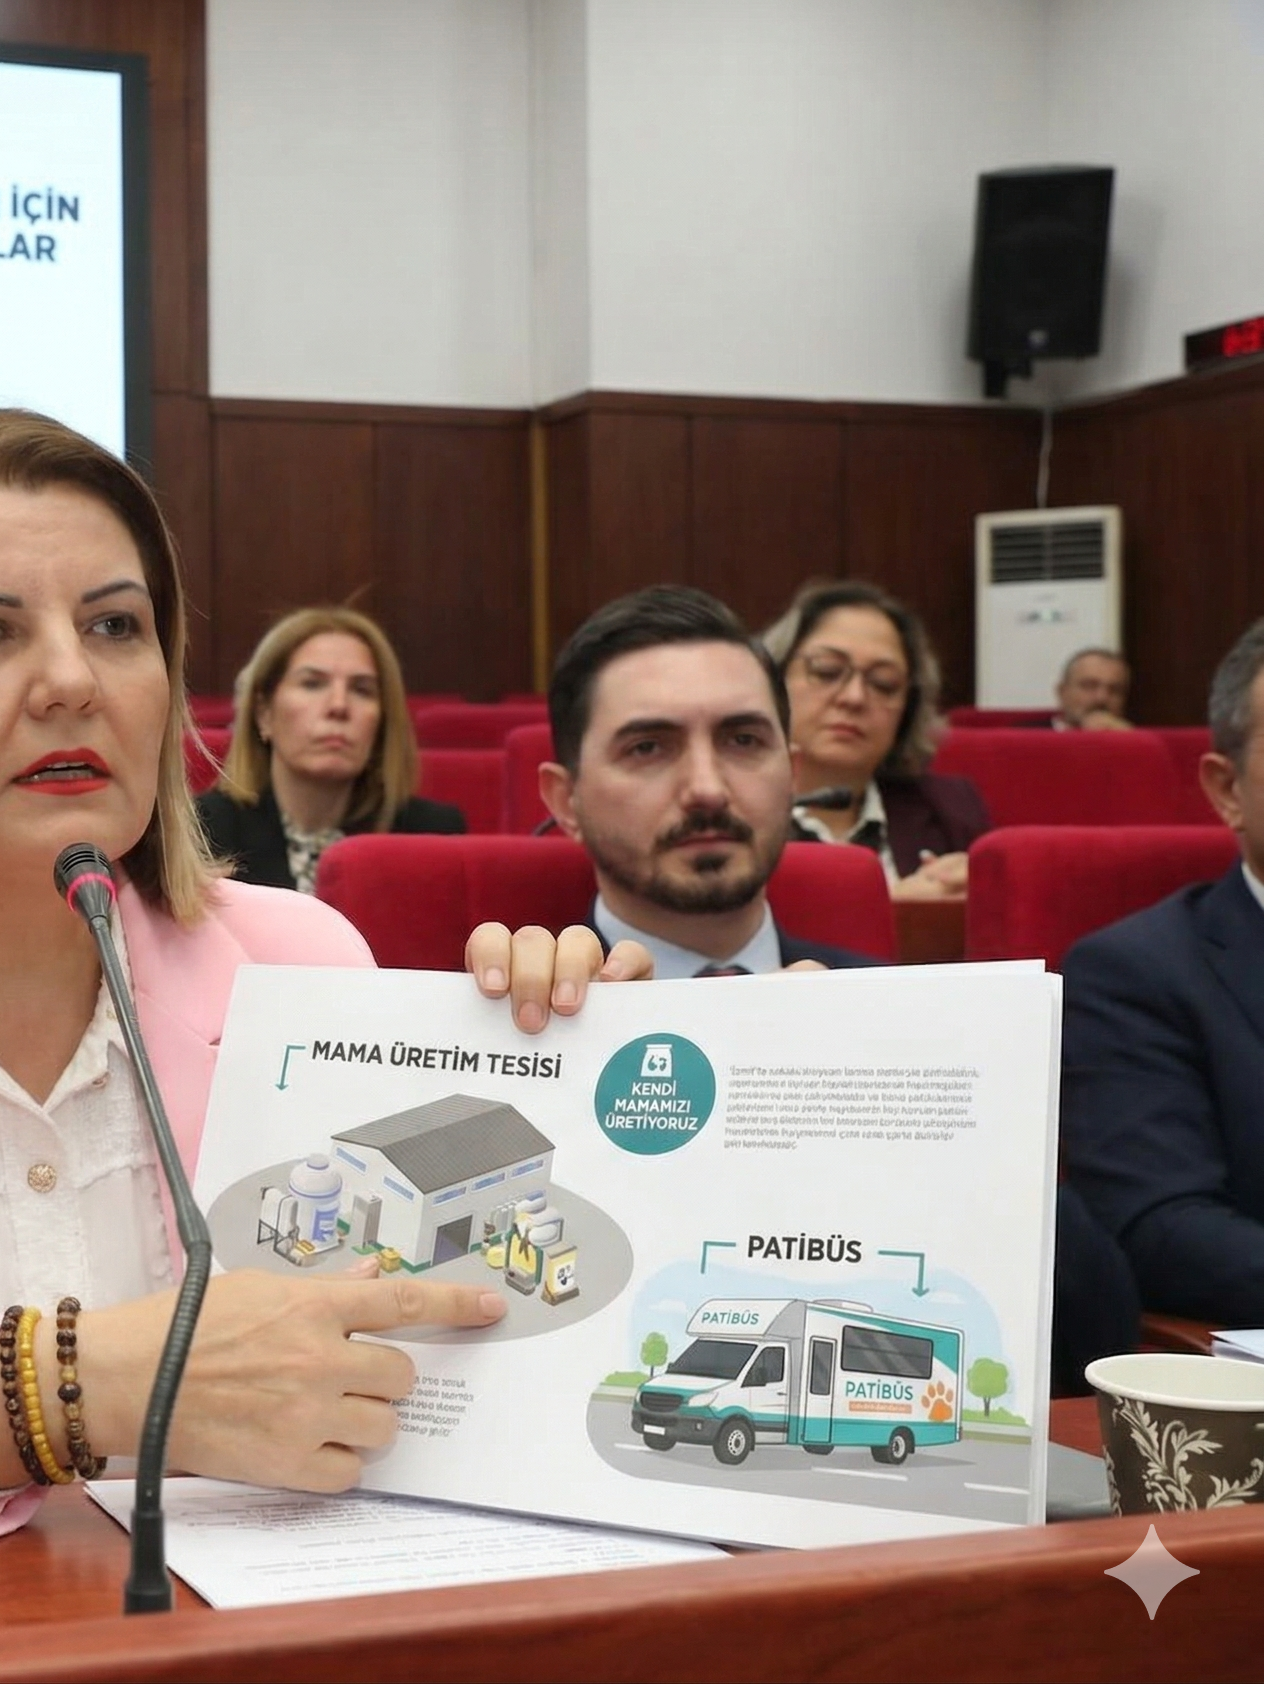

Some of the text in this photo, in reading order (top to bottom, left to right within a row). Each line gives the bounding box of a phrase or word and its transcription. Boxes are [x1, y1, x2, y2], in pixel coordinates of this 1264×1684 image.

[11, 183, 81, 224] İÇİN
[312, 1040, 563, 1079] MAMA ÜRETİM TESİSİ
[631, 1079, 677, 1096] KENDİ
[614, 1098, 692, 1114] MAMAMIZI
[604, 1112, 699, 1131] ÜRETİYORUZ
[747, 1231, 863, 1264] PATİBÜS
